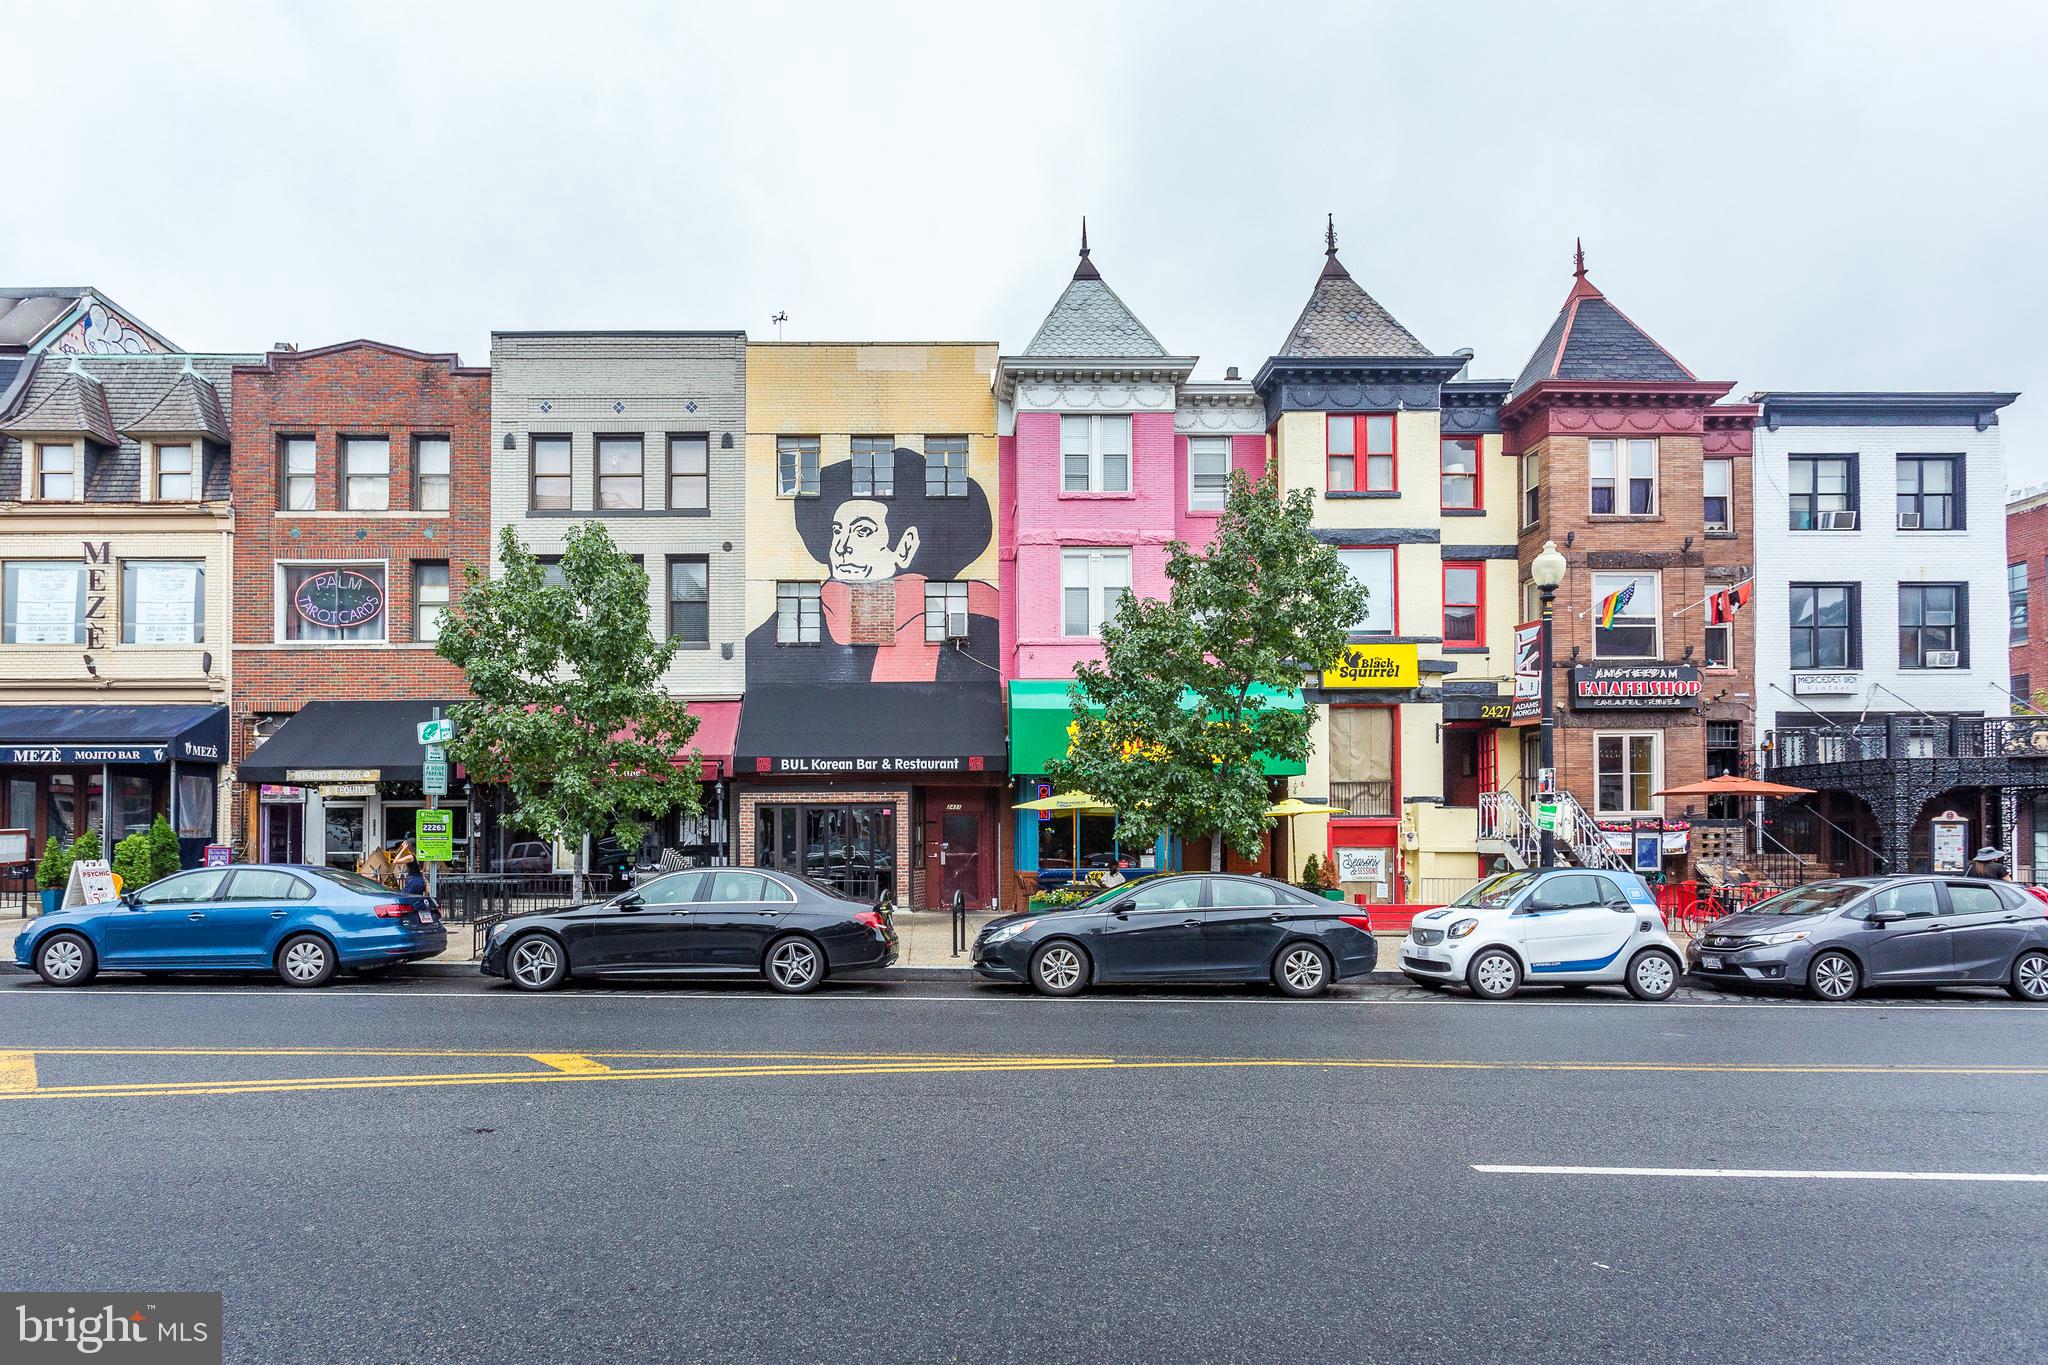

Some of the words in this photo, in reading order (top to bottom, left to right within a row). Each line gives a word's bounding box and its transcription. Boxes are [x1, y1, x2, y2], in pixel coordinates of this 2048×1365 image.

[315, 575, 362, 590] PALM
[82, 541, 111, 649] MEZÈ
[298, 594, 338, 623] TAROT
[338, 595, 379, 623] CARDS
[1361, 658, 1394, 668] Black
[1339, 665, 1400, 681] Squirrel
[1595, 668, 1678, 679] AMSTERDAM
[1798, 676, 1841, 684] MERCEDES
[1579, 680, 1702, 697] FALAFELSHOP
[1482, 705, 1510, 718] 2427
[1515, 701, 1539, 711] ADAMS
[1512, 707, 1541, 718] MORGAN
[13, 747, 62, 763] MEZÈ
[74, 751, 116, 760] MOJITO
[117, 751, 141, 760] BAR
[192, 745, 218, 758] MEZÈ
[781, 759, 808, 770] BUL
[811, 758, 853, 770] Korean
[857, 758, 878, 770] Bar
[882, 759, 891, 770] &
[895, 758, 959, 770] Restaurant
[339, 770, 361, 780] TACOS
[335, 785, 368, 794] TEQUILA
[1342, 853, 1381, 870] Seasons
[82, 870, 111, 878] PSYCHIC
[1357, 866, 1379, 875] SESSIONS
